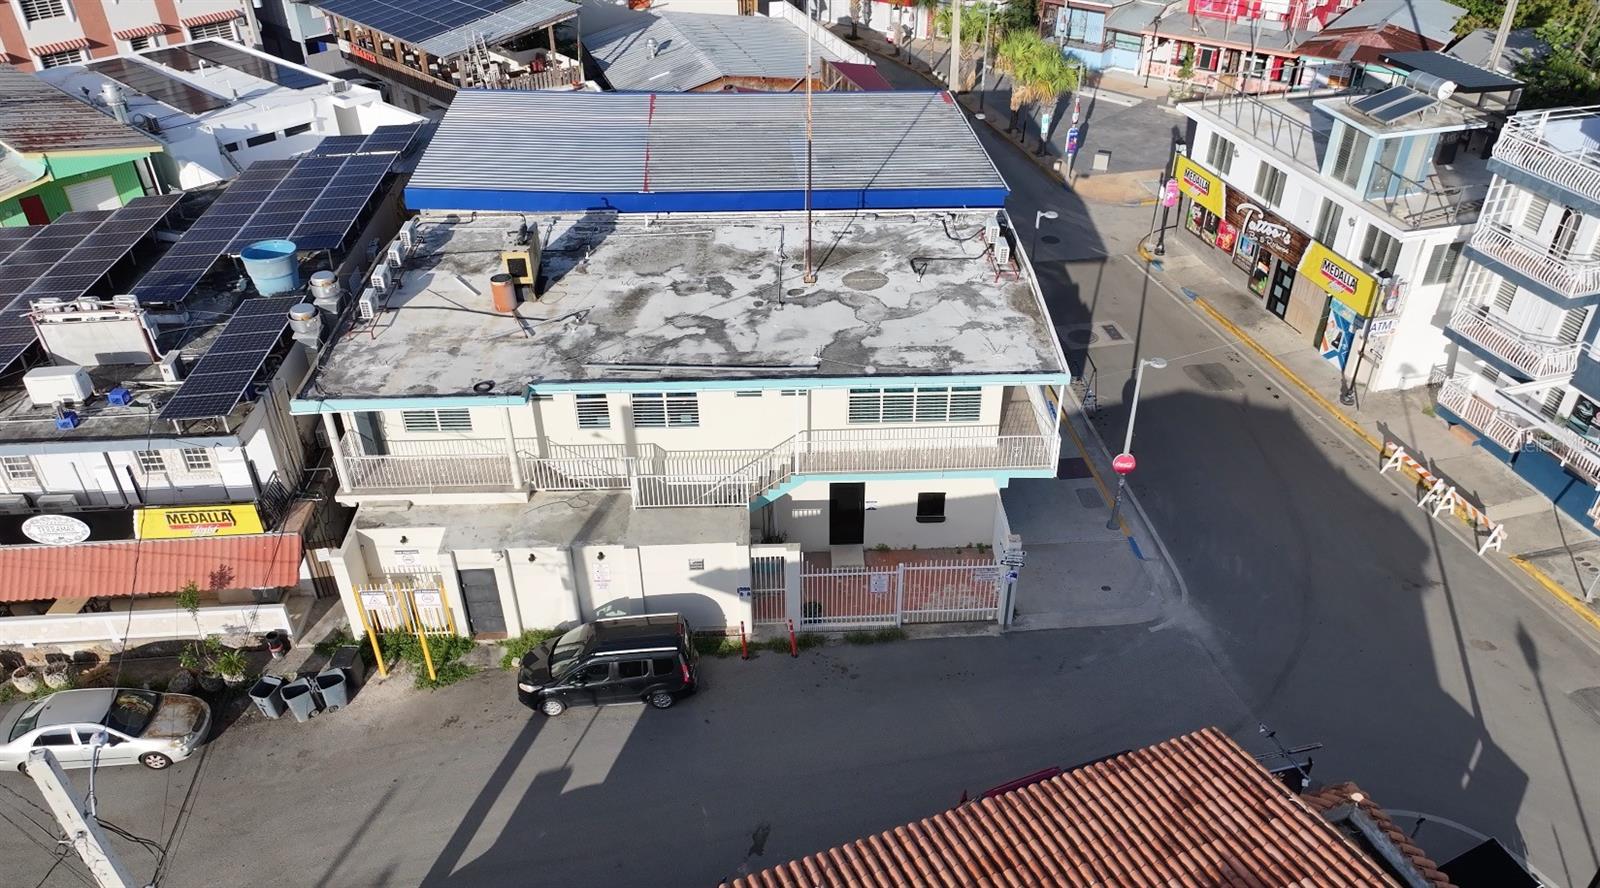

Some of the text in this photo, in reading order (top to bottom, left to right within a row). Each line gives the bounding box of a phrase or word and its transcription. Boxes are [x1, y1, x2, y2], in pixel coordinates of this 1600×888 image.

[1184, 168, 1209, 192] MEDALLA
[1322, 260, 1356, 289] MEDALLA
[1370, 320, 1393, 332] ATM
[166, 511, 231, 524] MEDALLA
